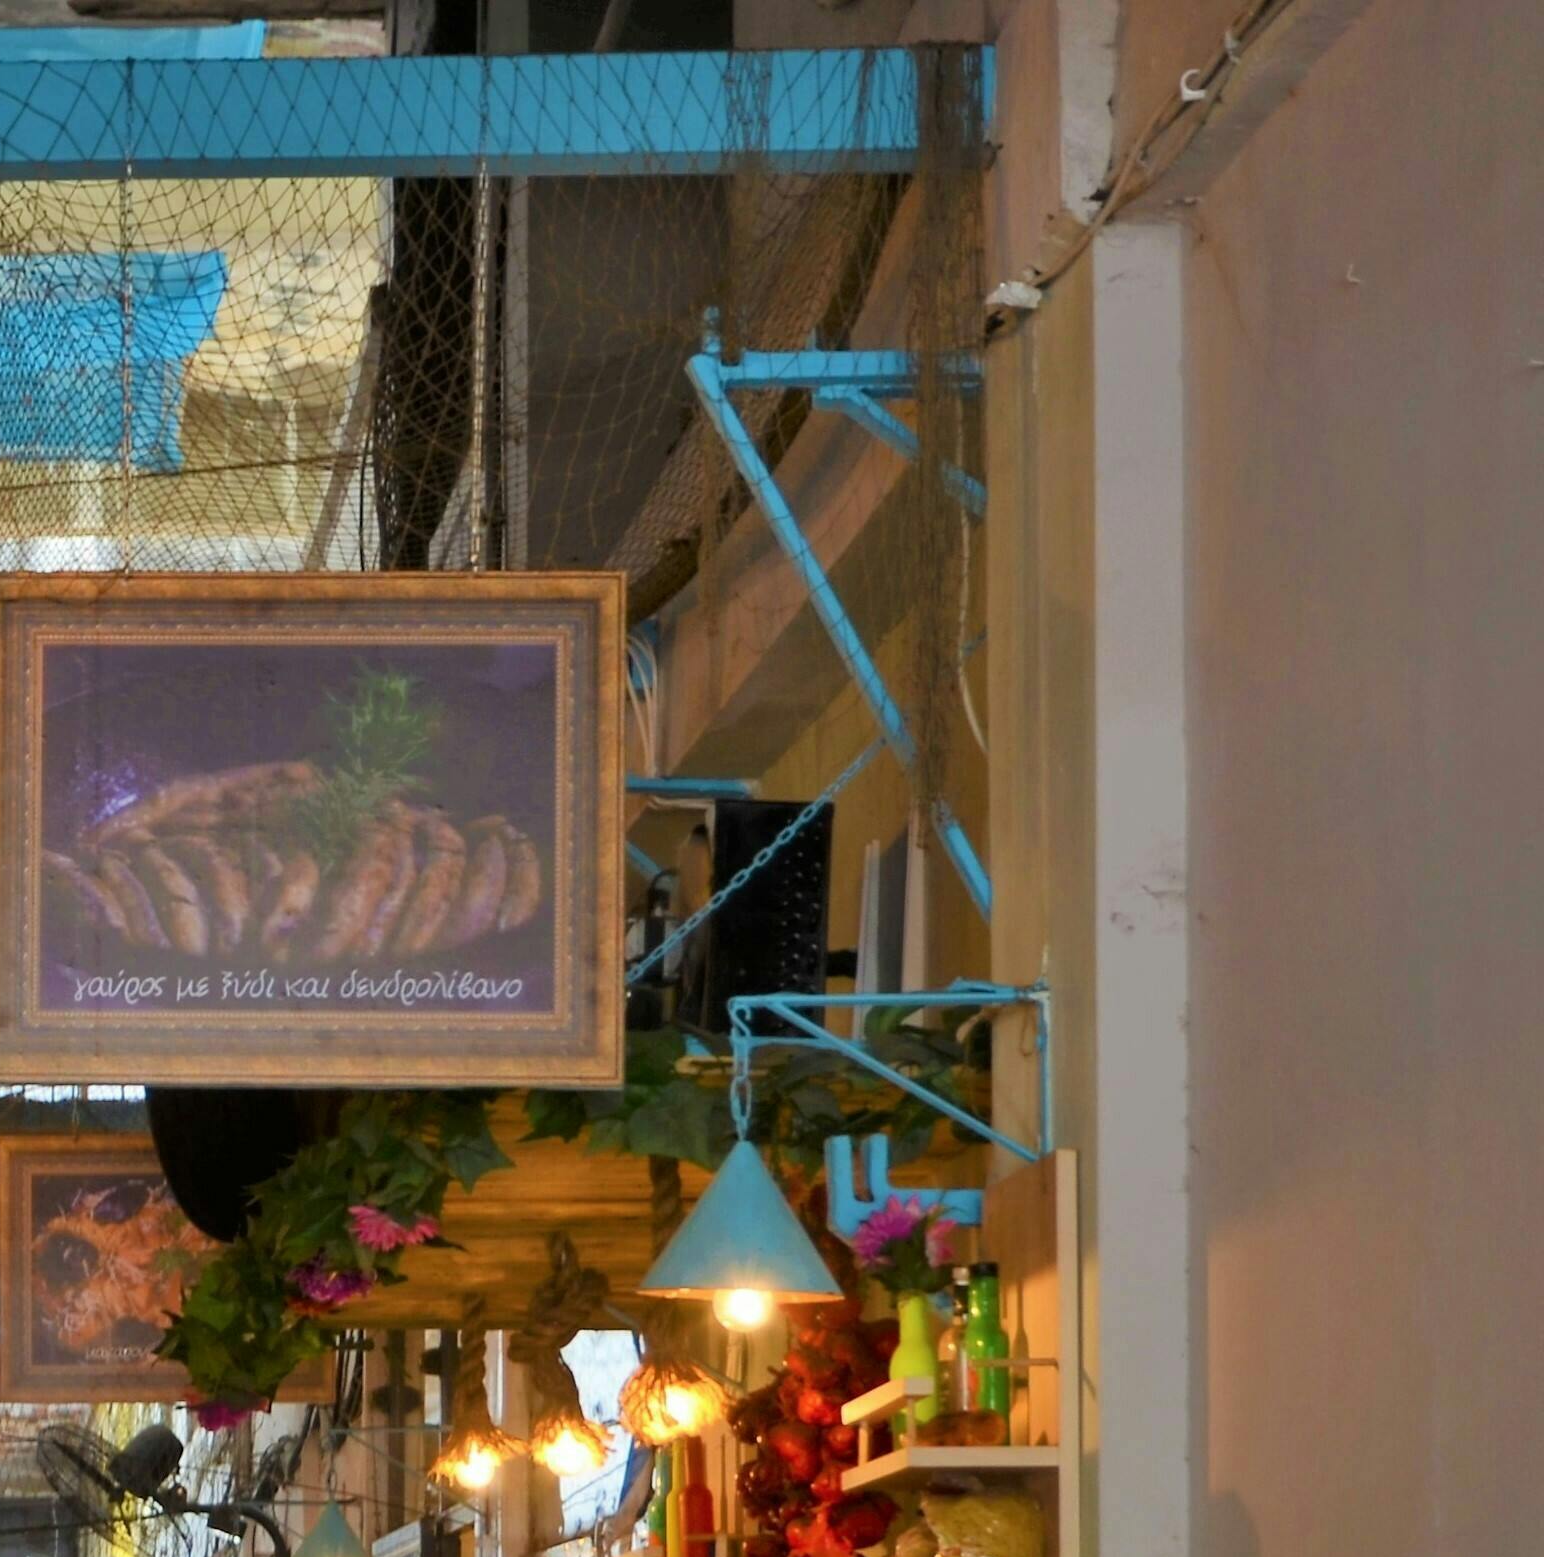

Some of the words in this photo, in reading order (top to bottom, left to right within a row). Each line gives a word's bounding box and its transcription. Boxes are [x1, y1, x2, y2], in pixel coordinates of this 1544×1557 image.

[73, 969, 168, 1007] γαύρος
[175, 976, 209, 1003] με
[219, 968, 276, 1002] ξύδι
[284, 975, 332, 1001] και
[339, 968, 523, 1008] δενδρολίβανο
